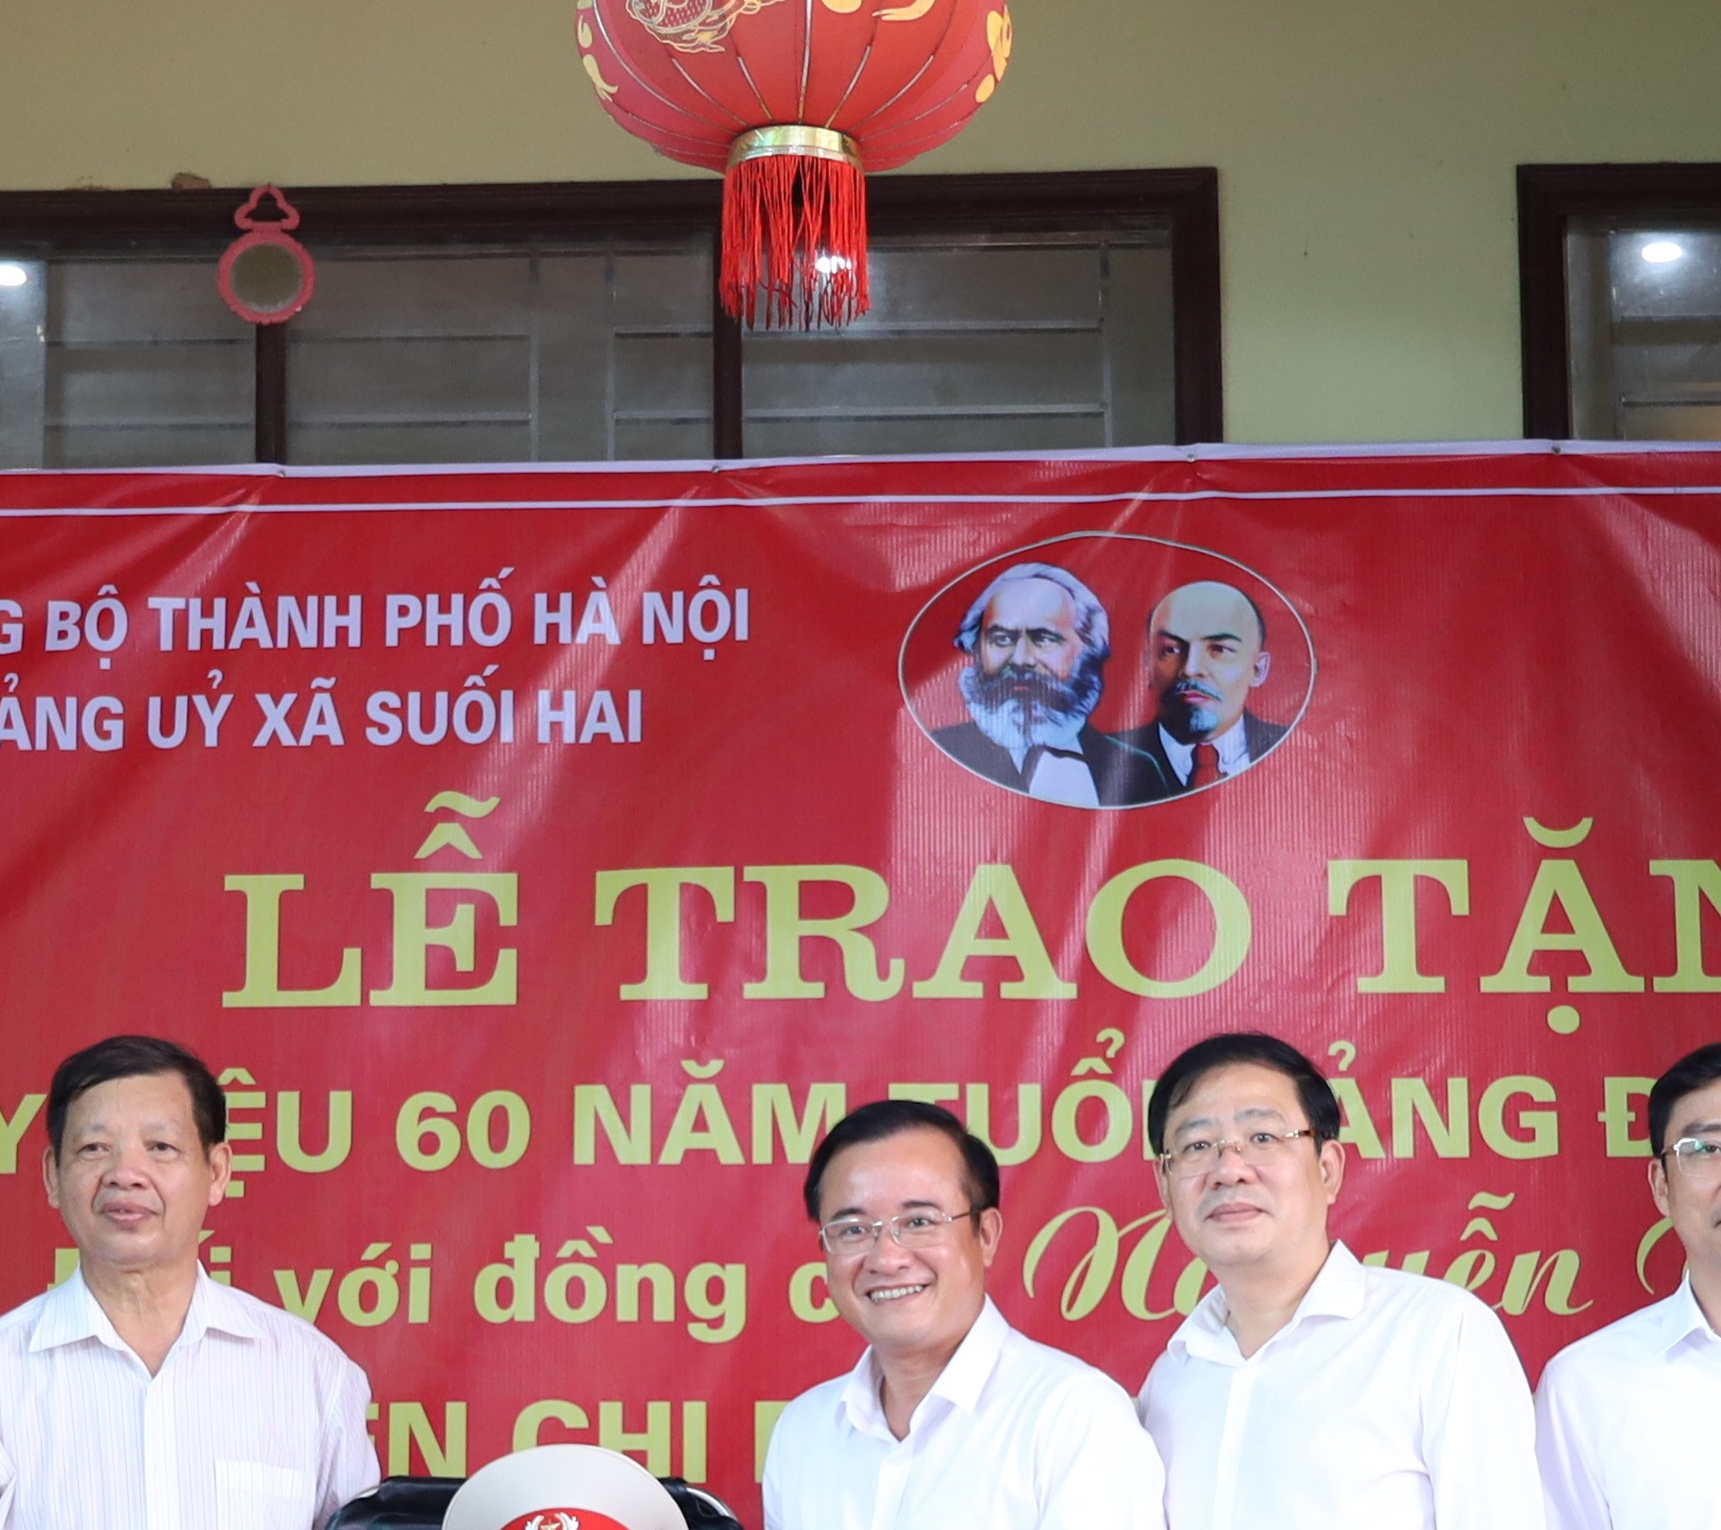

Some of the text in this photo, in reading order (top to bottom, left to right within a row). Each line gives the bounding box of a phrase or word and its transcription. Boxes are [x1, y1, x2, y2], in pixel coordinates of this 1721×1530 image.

[45, 580, 127, 670] BỘ
[147, 581, 362, 651] THÀNH
[385, 567, 515, 648] PHỐ
[533, 577, 626, 646] HÀ
[642, 574, 750, 661] NỘI
[147, 669, 234, 749] UỶ
[252, 677, 345, 747] XÃ
[365, 664, 515, 746] SUỐI
[536, 677, 642, 744] HAI
[223, 791, 518, 1007] LỄ
[594, 860, 1252, 1002] TRAO
[396, 1090, 531, 1172] 60
[574, 1060, 847, 1166] NĂM
[1328, 1041, 1559, 1160] ẢNG
[274, 1243, 432, 1326] với
[474, 1226, 746, 1343] đồng
[512, 1400, 707, 1483] CHI
